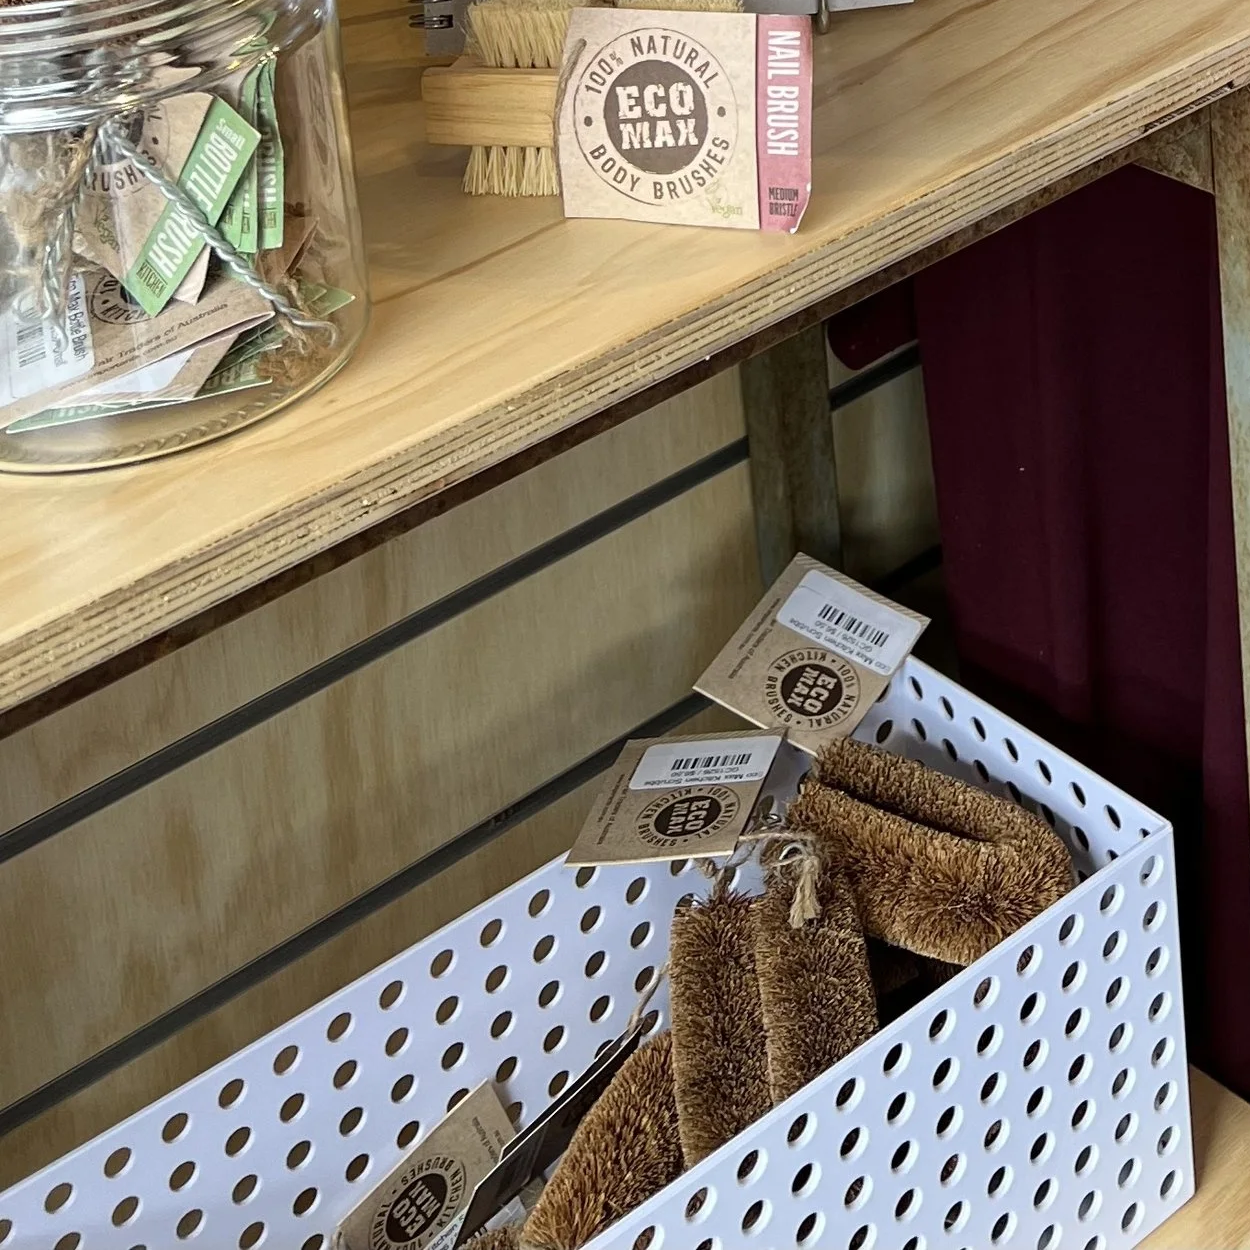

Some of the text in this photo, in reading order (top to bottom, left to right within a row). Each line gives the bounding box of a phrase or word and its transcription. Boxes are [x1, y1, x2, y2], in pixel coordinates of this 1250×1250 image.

[584, 35, 720, 94] 100% NATURAL
[615, 82, 695, 120] ECO
[766, 30, 801, 156] NAIL BRUSH
[215, 118, 246, 150] Small
[619, 118, 699, 150] MAX
[186, 132, 240, 212] BOTTLE
[589, 136, 730, 200] BODY BRUSHES
[768, 187, 799, 201] MEDIUM
[768, 202, 798, 217] BRISTLE
[136, 261, 168, 299] KITCHEN
[68, 311, 89, 336] Bottle
[69, 334, 92, 362] Brush
[823, 635, 855, 656] Kitchen
[766, 650, 826, 723] KITCHEN BRUSHES
[788, 667, 819, 707] MAX
[803, 673, 838, 715] ECO
[809, 694, 856, 728] NATURAL
[685, 774, 721, 784] Kitchen
[638, 787, 692, 847] KITCHEN BRUSHES
[666, 802, 690, 835] MAX
[685, 799, 712, 831] ECO
[698, 801, 735, 839] NATURAL
[402, 1157, 454, 1185] BRUSHES
[409, 1180, 441, 1218] MAX
[436, 1168, 462, 1228] KITCHEN
[392, 1199, 426, 1238] ECO
